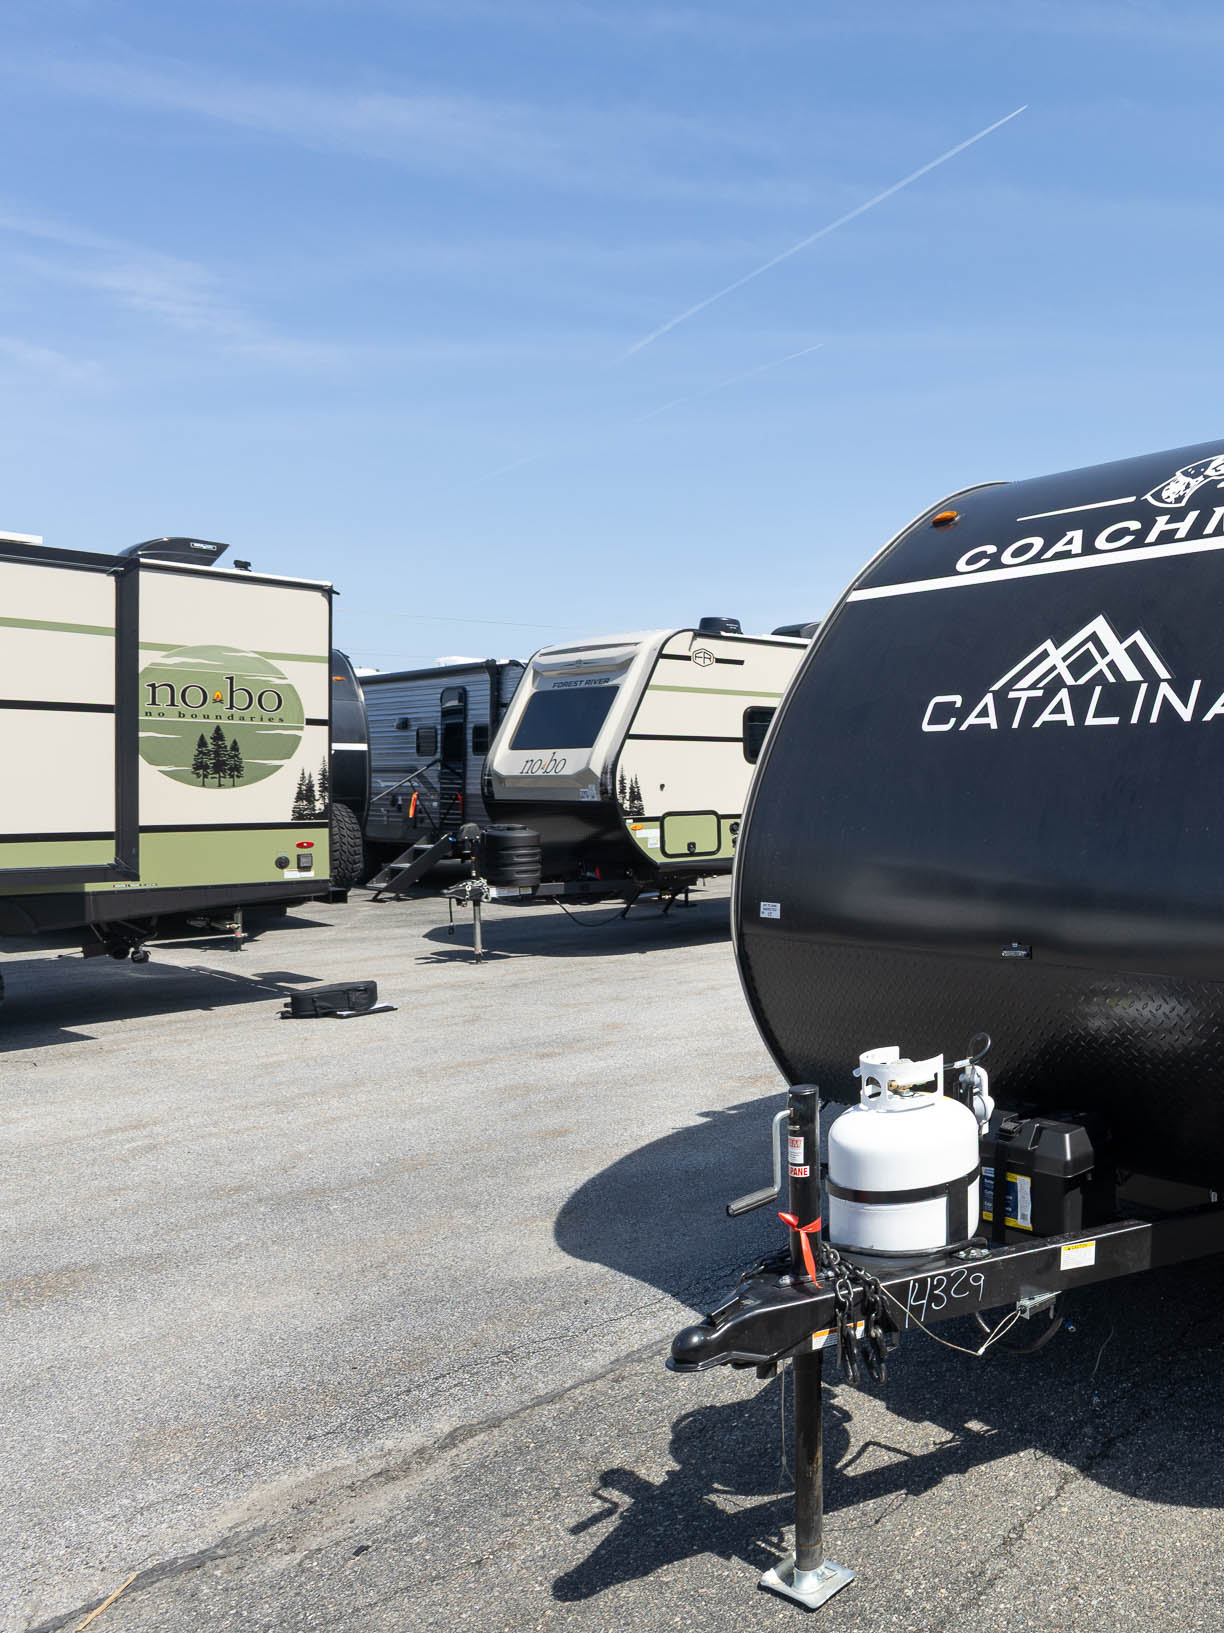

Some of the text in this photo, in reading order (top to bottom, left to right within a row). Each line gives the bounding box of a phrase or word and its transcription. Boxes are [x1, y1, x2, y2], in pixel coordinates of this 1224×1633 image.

[552, 677, 610, 689] FOREST RIVER
[178, 711, 284, 723] boundaries
[905, 1268, 984, 1329] 14329
